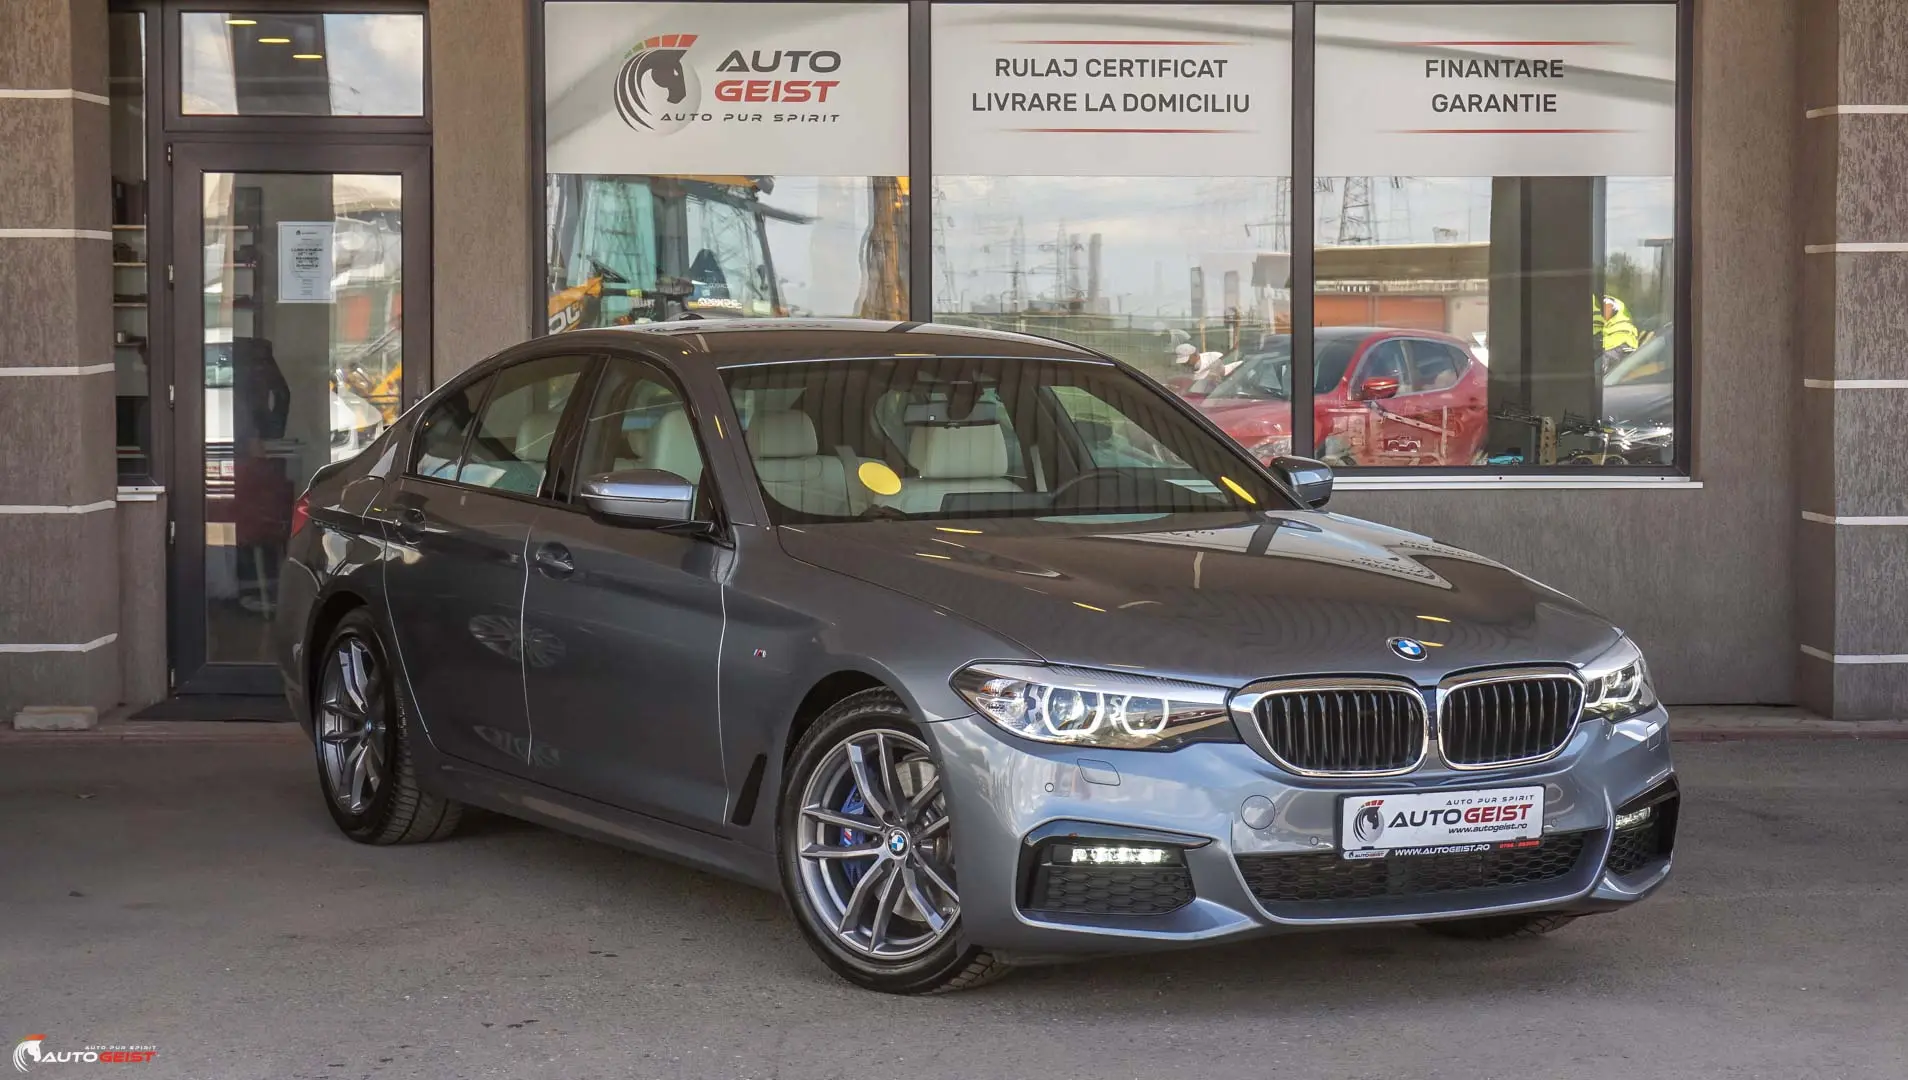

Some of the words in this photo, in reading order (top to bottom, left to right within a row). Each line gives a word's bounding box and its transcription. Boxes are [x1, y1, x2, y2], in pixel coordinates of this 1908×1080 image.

[715, 49, 842, 73] AUTO
[995, 58, 1078, 78] RULAJ
[1085, 58, 1228, 78] CERTIFICAT
[1425, 59, 1564, 78] FINANTARE
[714, 79, 841, 103] GEIST
[972, 92, 1077, 112] LIVRARE
[1085, 93, 1116, 112] LA
[1123, 93, 1250, 113] DOMICILIU
[1431, 93, 1557, 113] GARANTIE
[660, 112, 713, 122] AUTO
[723, 112, 763, 122] PUR
[773, 112, 840, 123] SPIRIT
[1446, 798, 1473, 806] AUTO
[1502, 794, 1535, 803] SPIRIT
[1448, 823, 1528, 834] www.autogeist.ro
[1394, 843, 1490, 857] WWW.AUTOGEIST.RO
